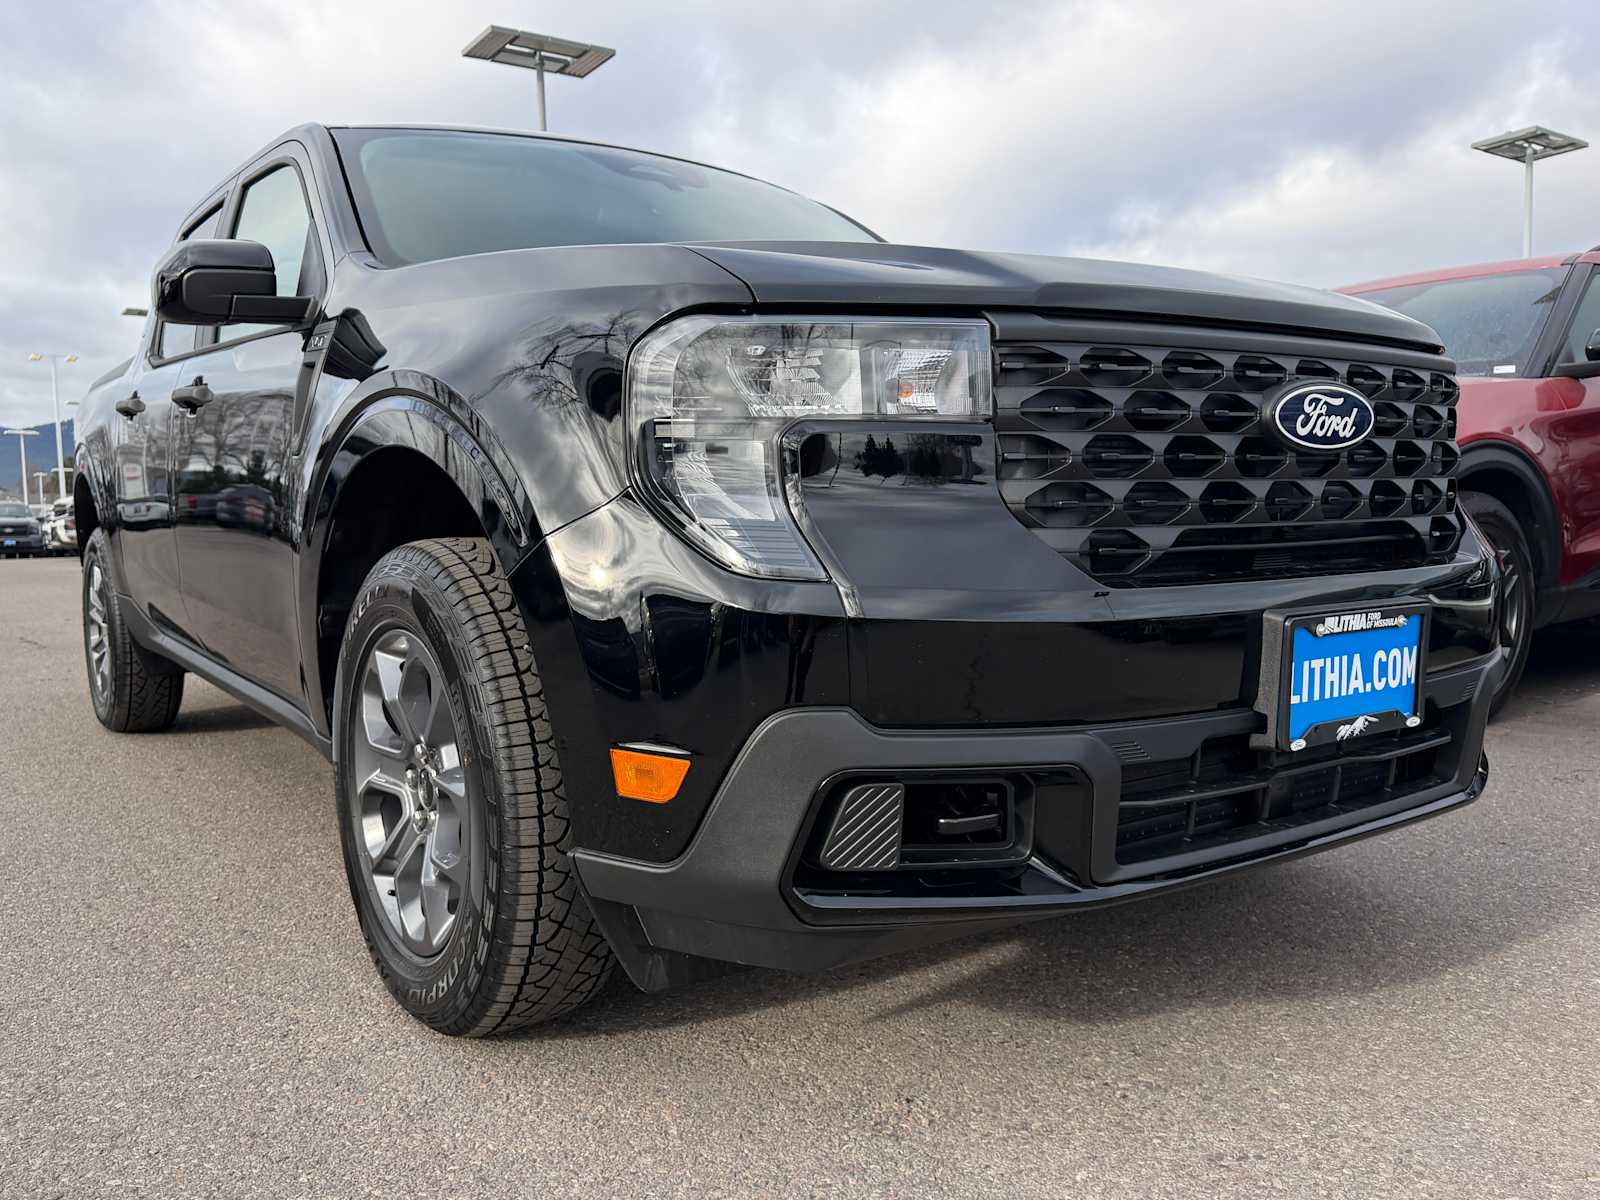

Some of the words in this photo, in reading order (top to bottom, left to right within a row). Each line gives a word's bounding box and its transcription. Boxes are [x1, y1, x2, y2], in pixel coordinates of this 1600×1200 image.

[1296, 393, 1359, 438] Ford
[1333, 613, 1367, 633] LITHIA
[1290, 645, 1418, 705] LITHIA.COM
